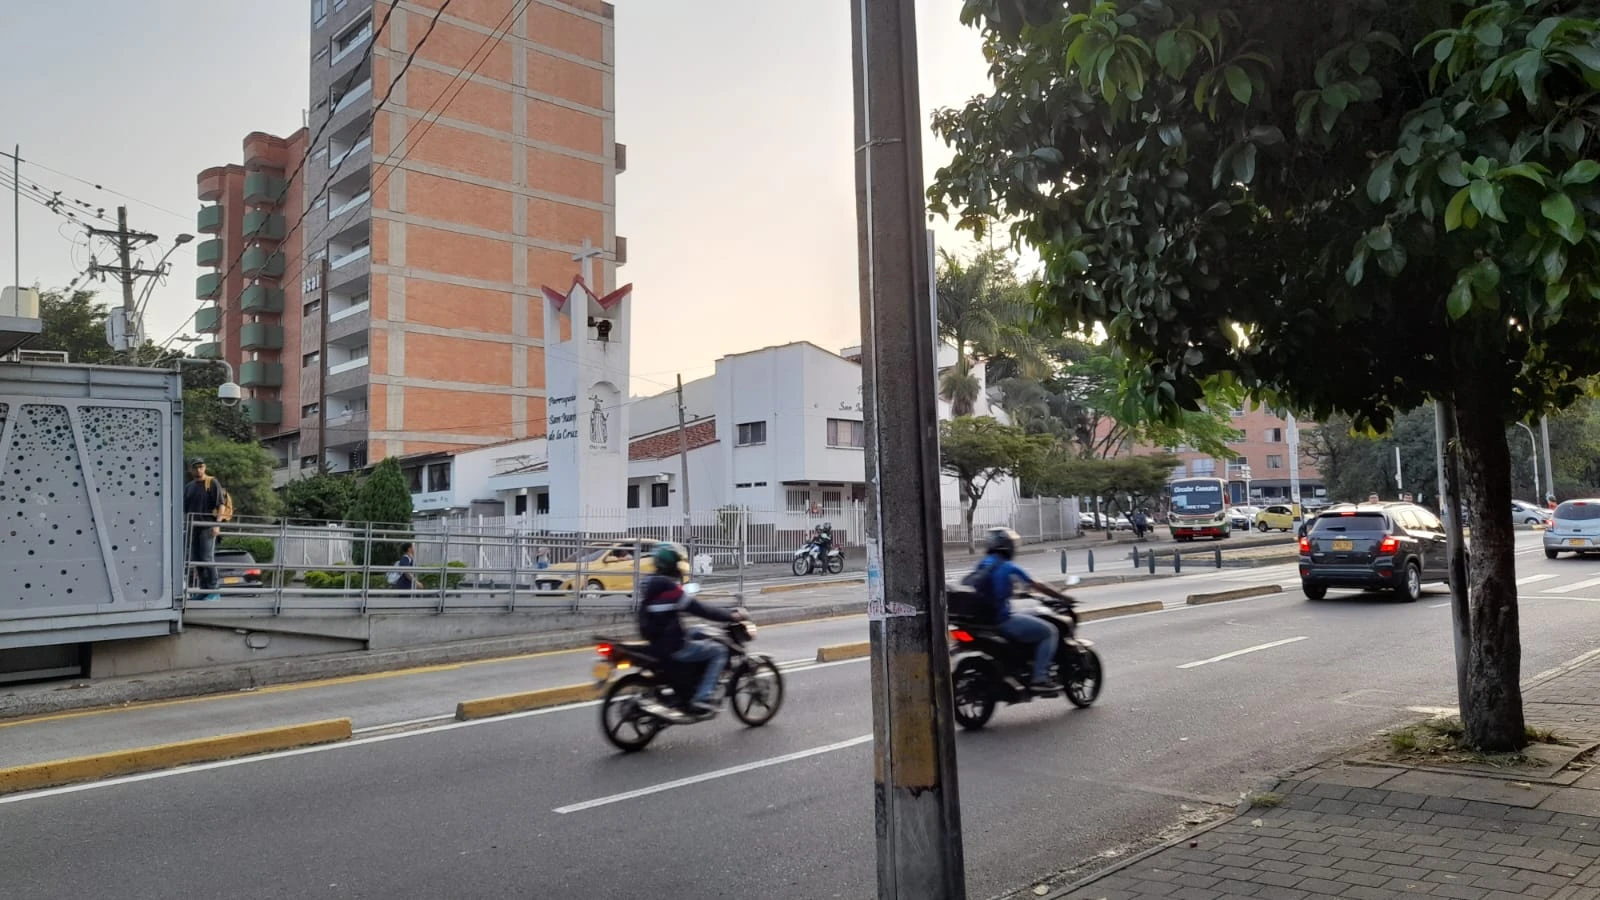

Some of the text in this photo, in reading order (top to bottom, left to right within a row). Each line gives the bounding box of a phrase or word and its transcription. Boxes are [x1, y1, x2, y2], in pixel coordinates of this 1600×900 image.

[549, 412, 576, 425] San Juan
[548, 428, 578, 441] de la Cruz
